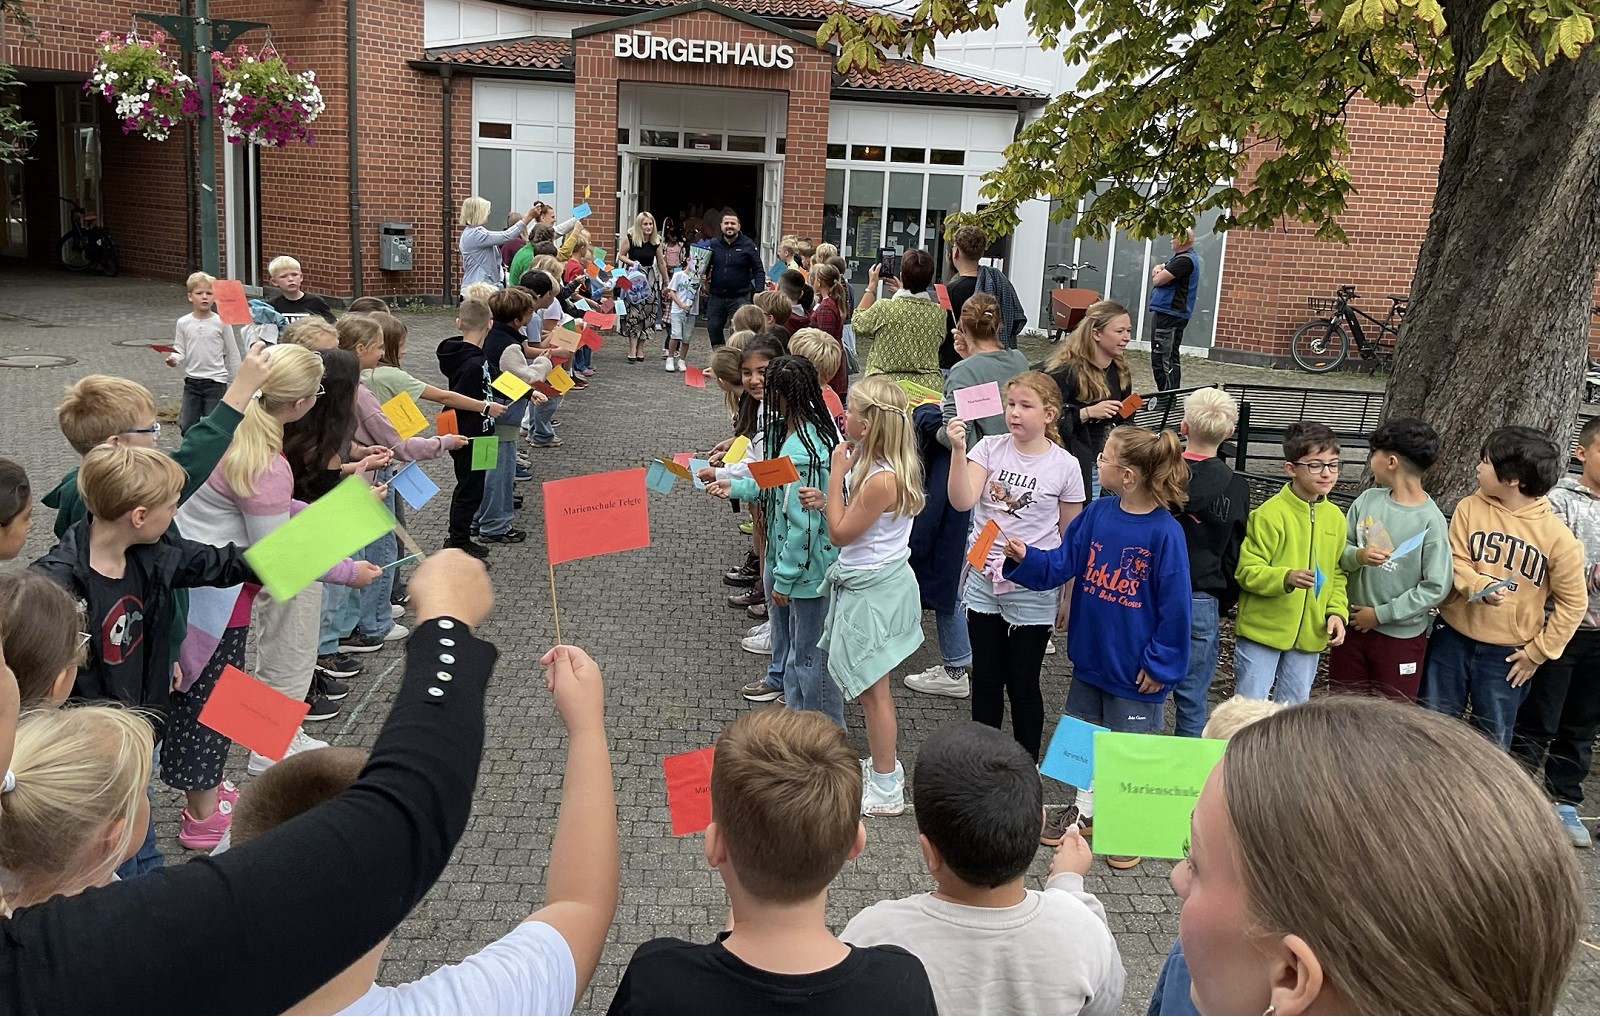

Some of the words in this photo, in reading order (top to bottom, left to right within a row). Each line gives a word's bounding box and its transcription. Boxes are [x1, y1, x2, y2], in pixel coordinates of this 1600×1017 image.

[614, 29, 795, 70] BÜRGERHAUS
[563, 501, 616, 516] Marienschule
[618, 498, 642, 507] Telgte
